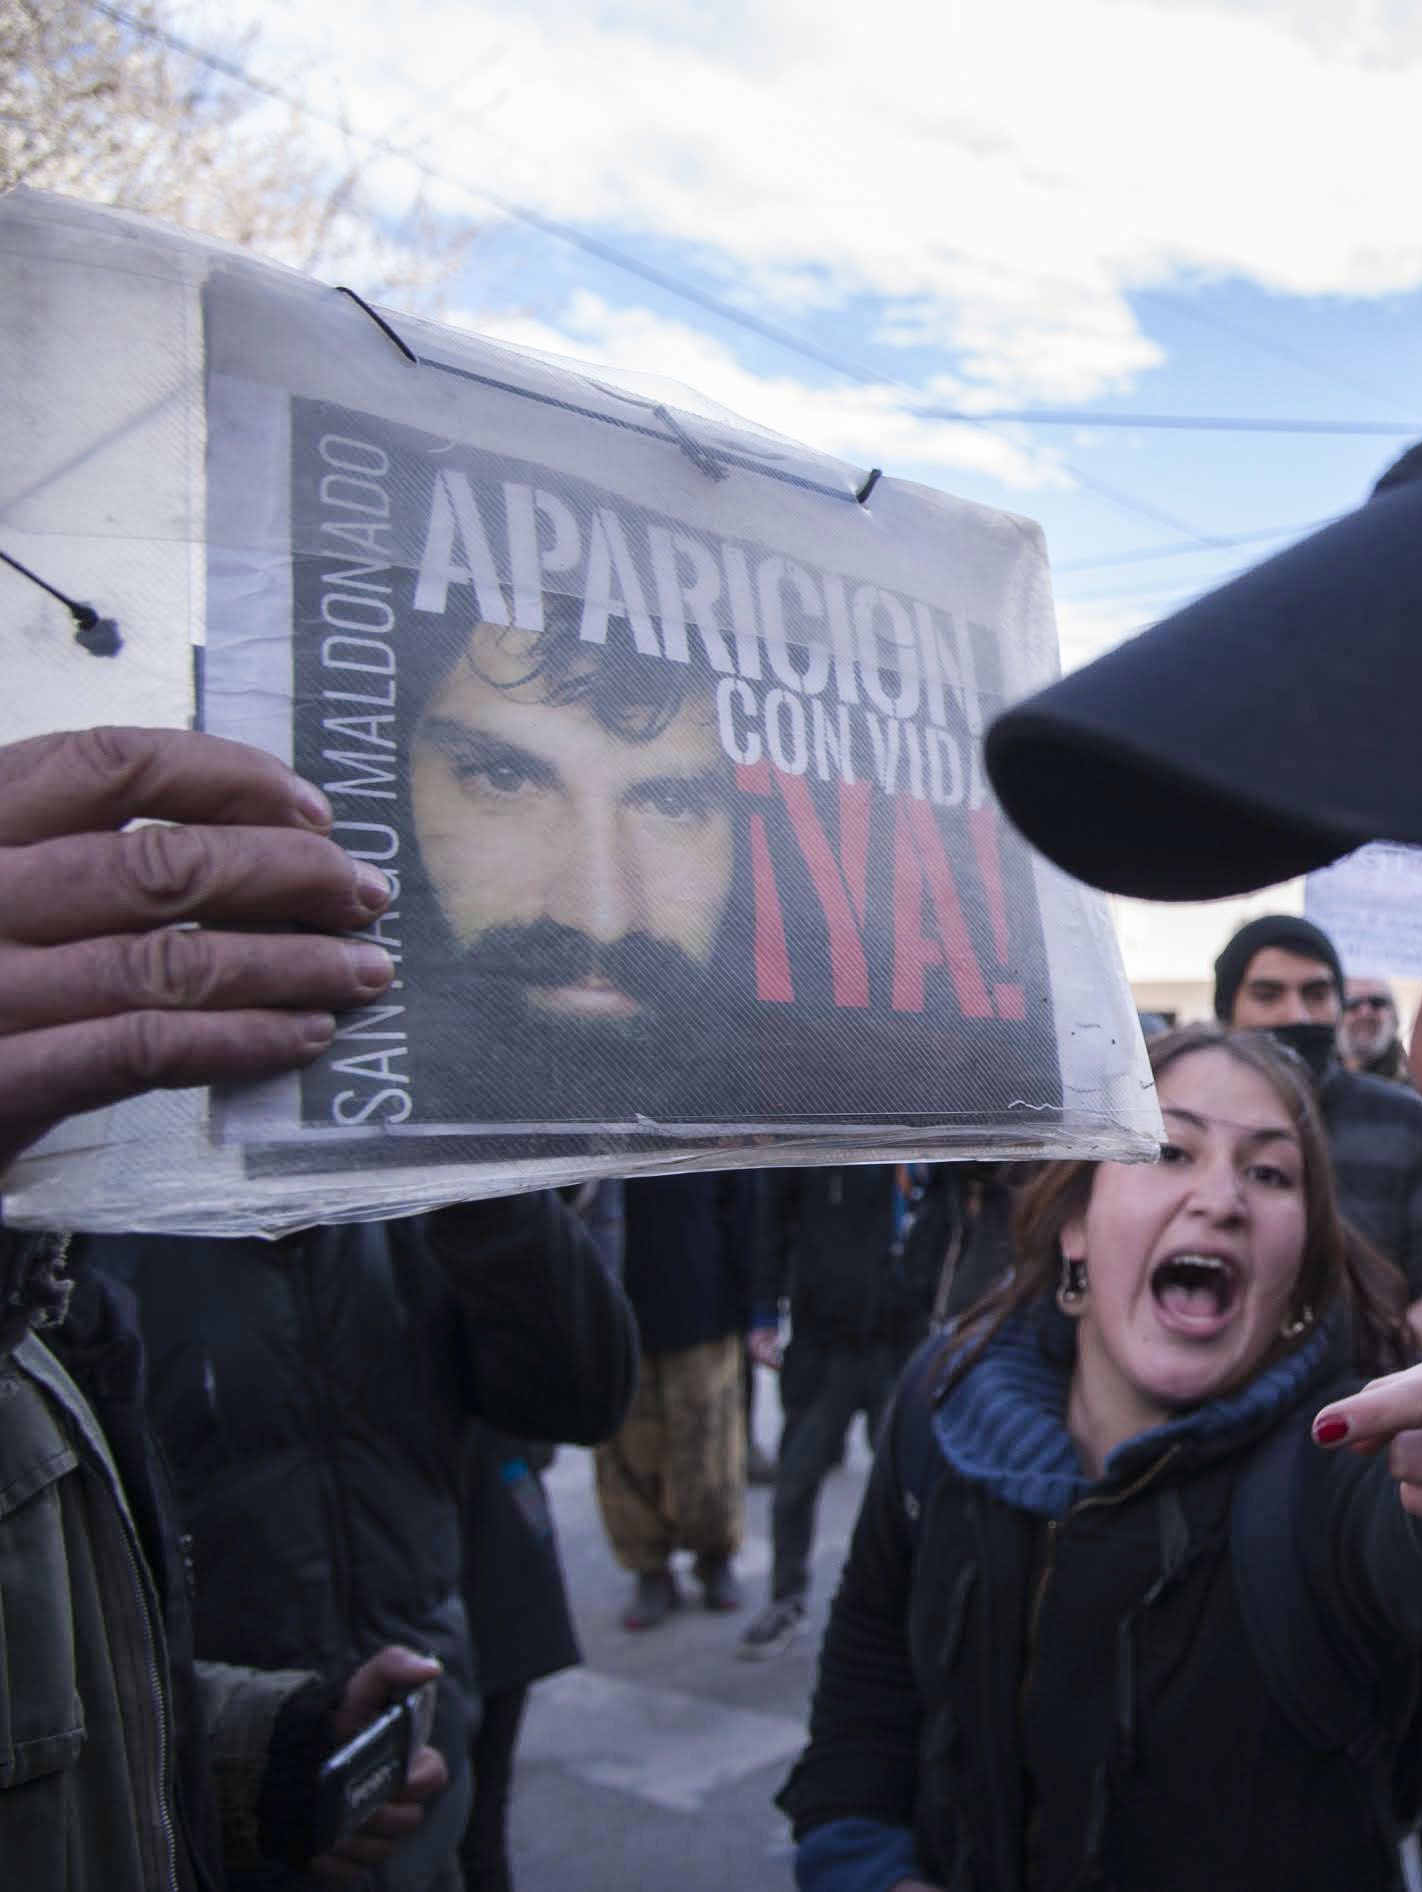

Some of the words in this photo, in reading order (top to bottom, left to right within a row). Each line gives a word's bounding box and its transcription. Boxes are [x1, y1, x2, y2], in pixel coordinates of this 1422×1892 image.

[319, 433, 398, 800] MALDONADO
[412, 467, 984, 731] APARICION
[716, 676, 857, 785] CON
[735, 757, 1025, 1020] ¡YA!
